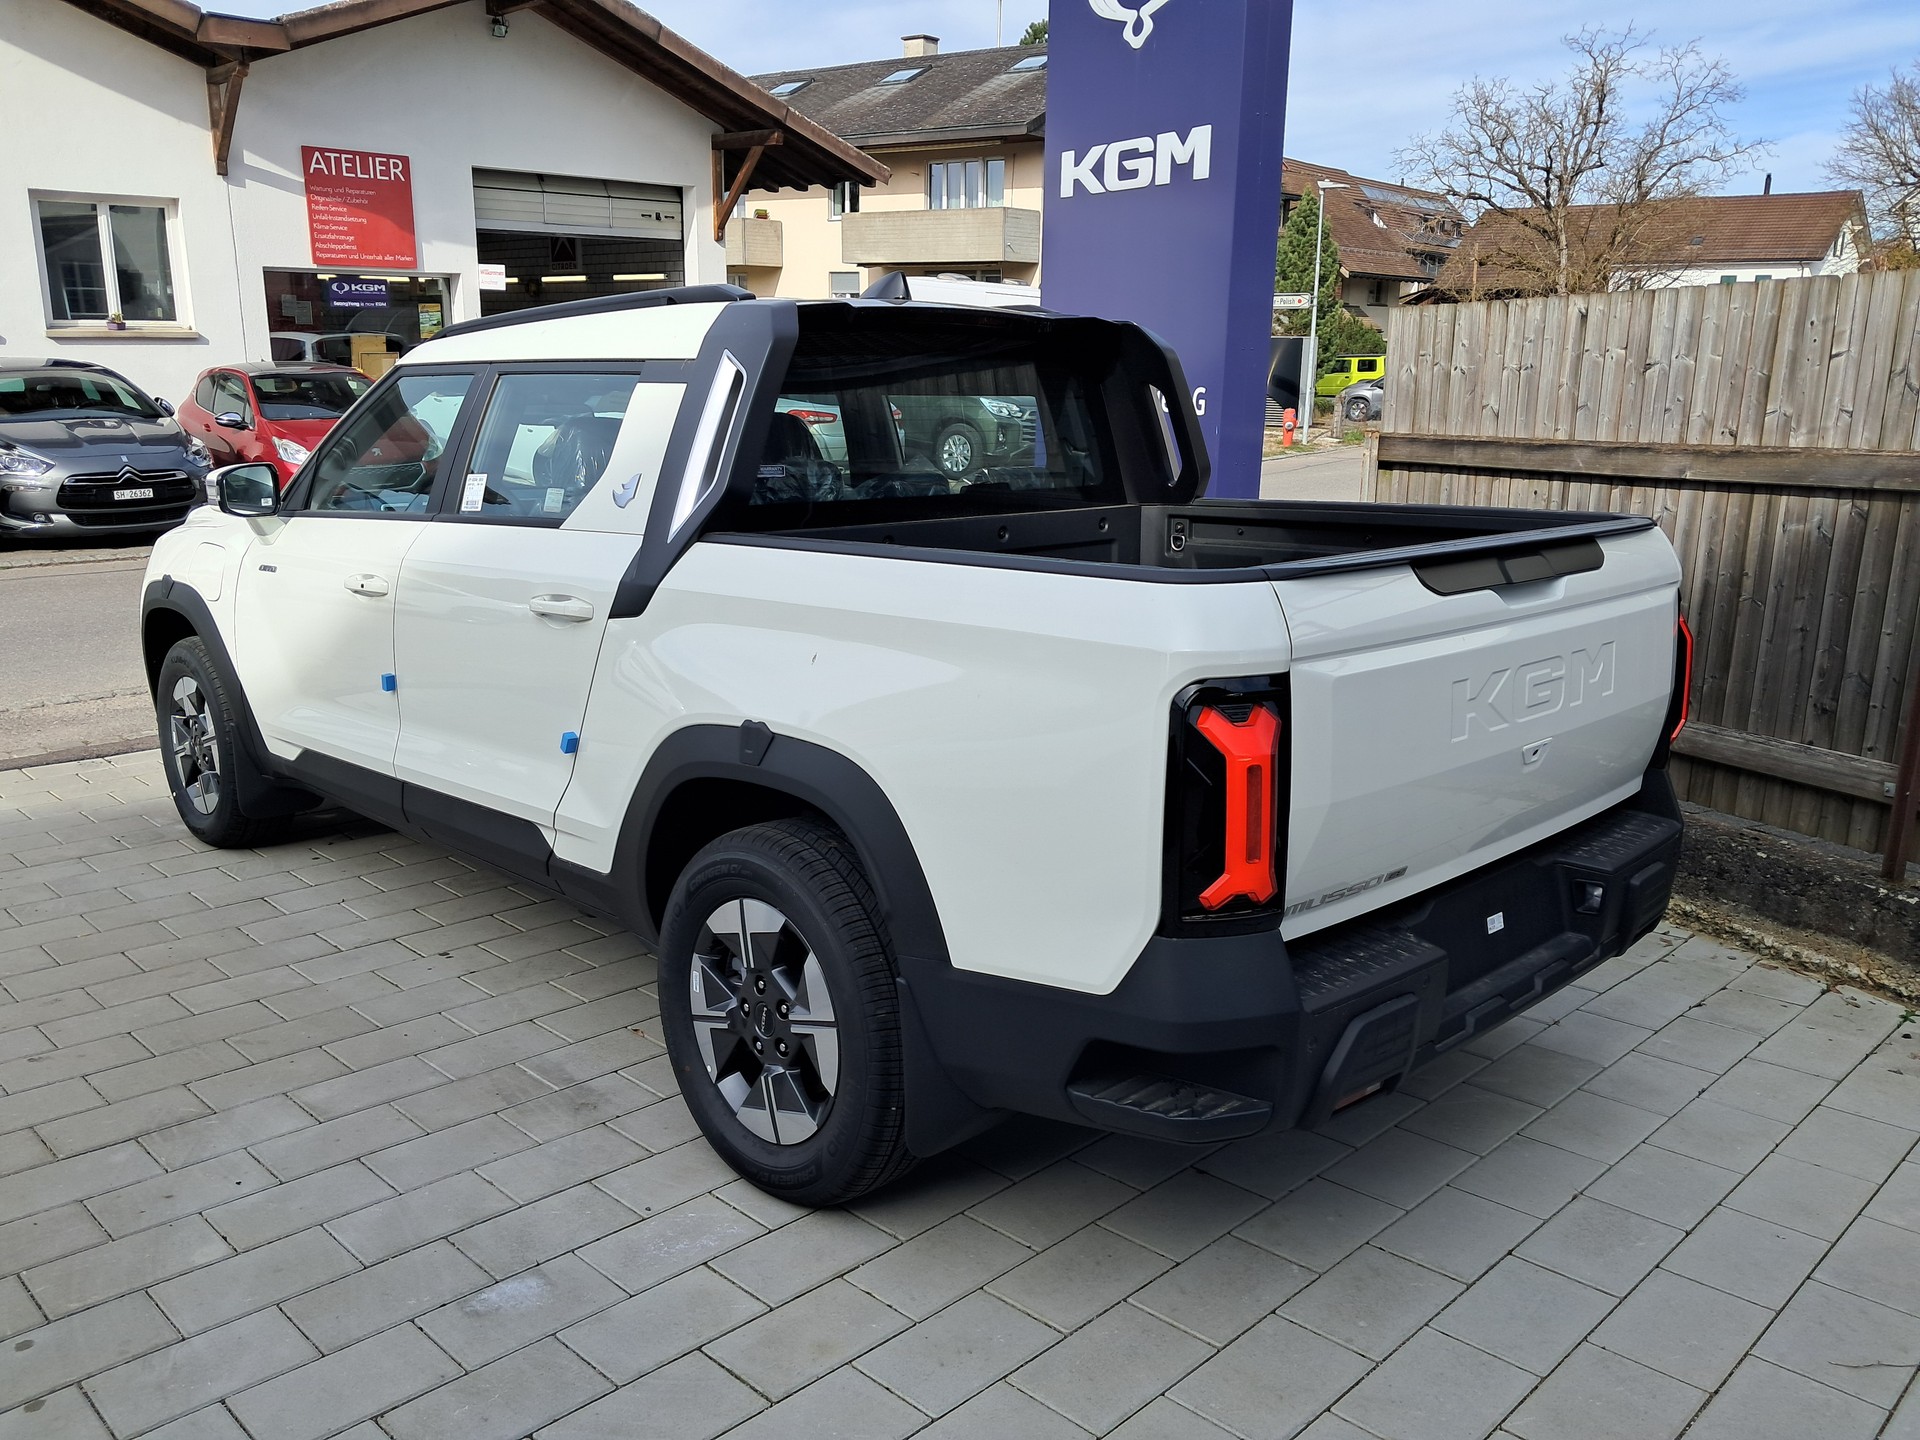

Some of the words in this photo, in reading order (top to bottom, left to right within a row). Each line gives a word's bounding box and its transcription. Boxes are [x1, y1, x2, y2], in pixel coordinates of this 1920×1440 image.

[1060, 124, 1212, 198] KGM
[309, 151, 405, 182] ATELIER
[309, 185, 333, 194] Wartung
[345, 187, 377, 196] Reparaturen
[314, 232, 355, 242] Ersatzfahrzeuge
[315, 242, 357, 250] Abschleppdienst
[316, 251, 348, 260] Reparaturen
[360, 253, 383, 261] Unterhalt
[351, 283, 386, 292] KGM
[115, 491, 126, 499] SH
[129, 489, 152, 498] 26362
[1450, 640, 1616, 743] KGM
[1284, 874, 1385, 917] MUSSO
